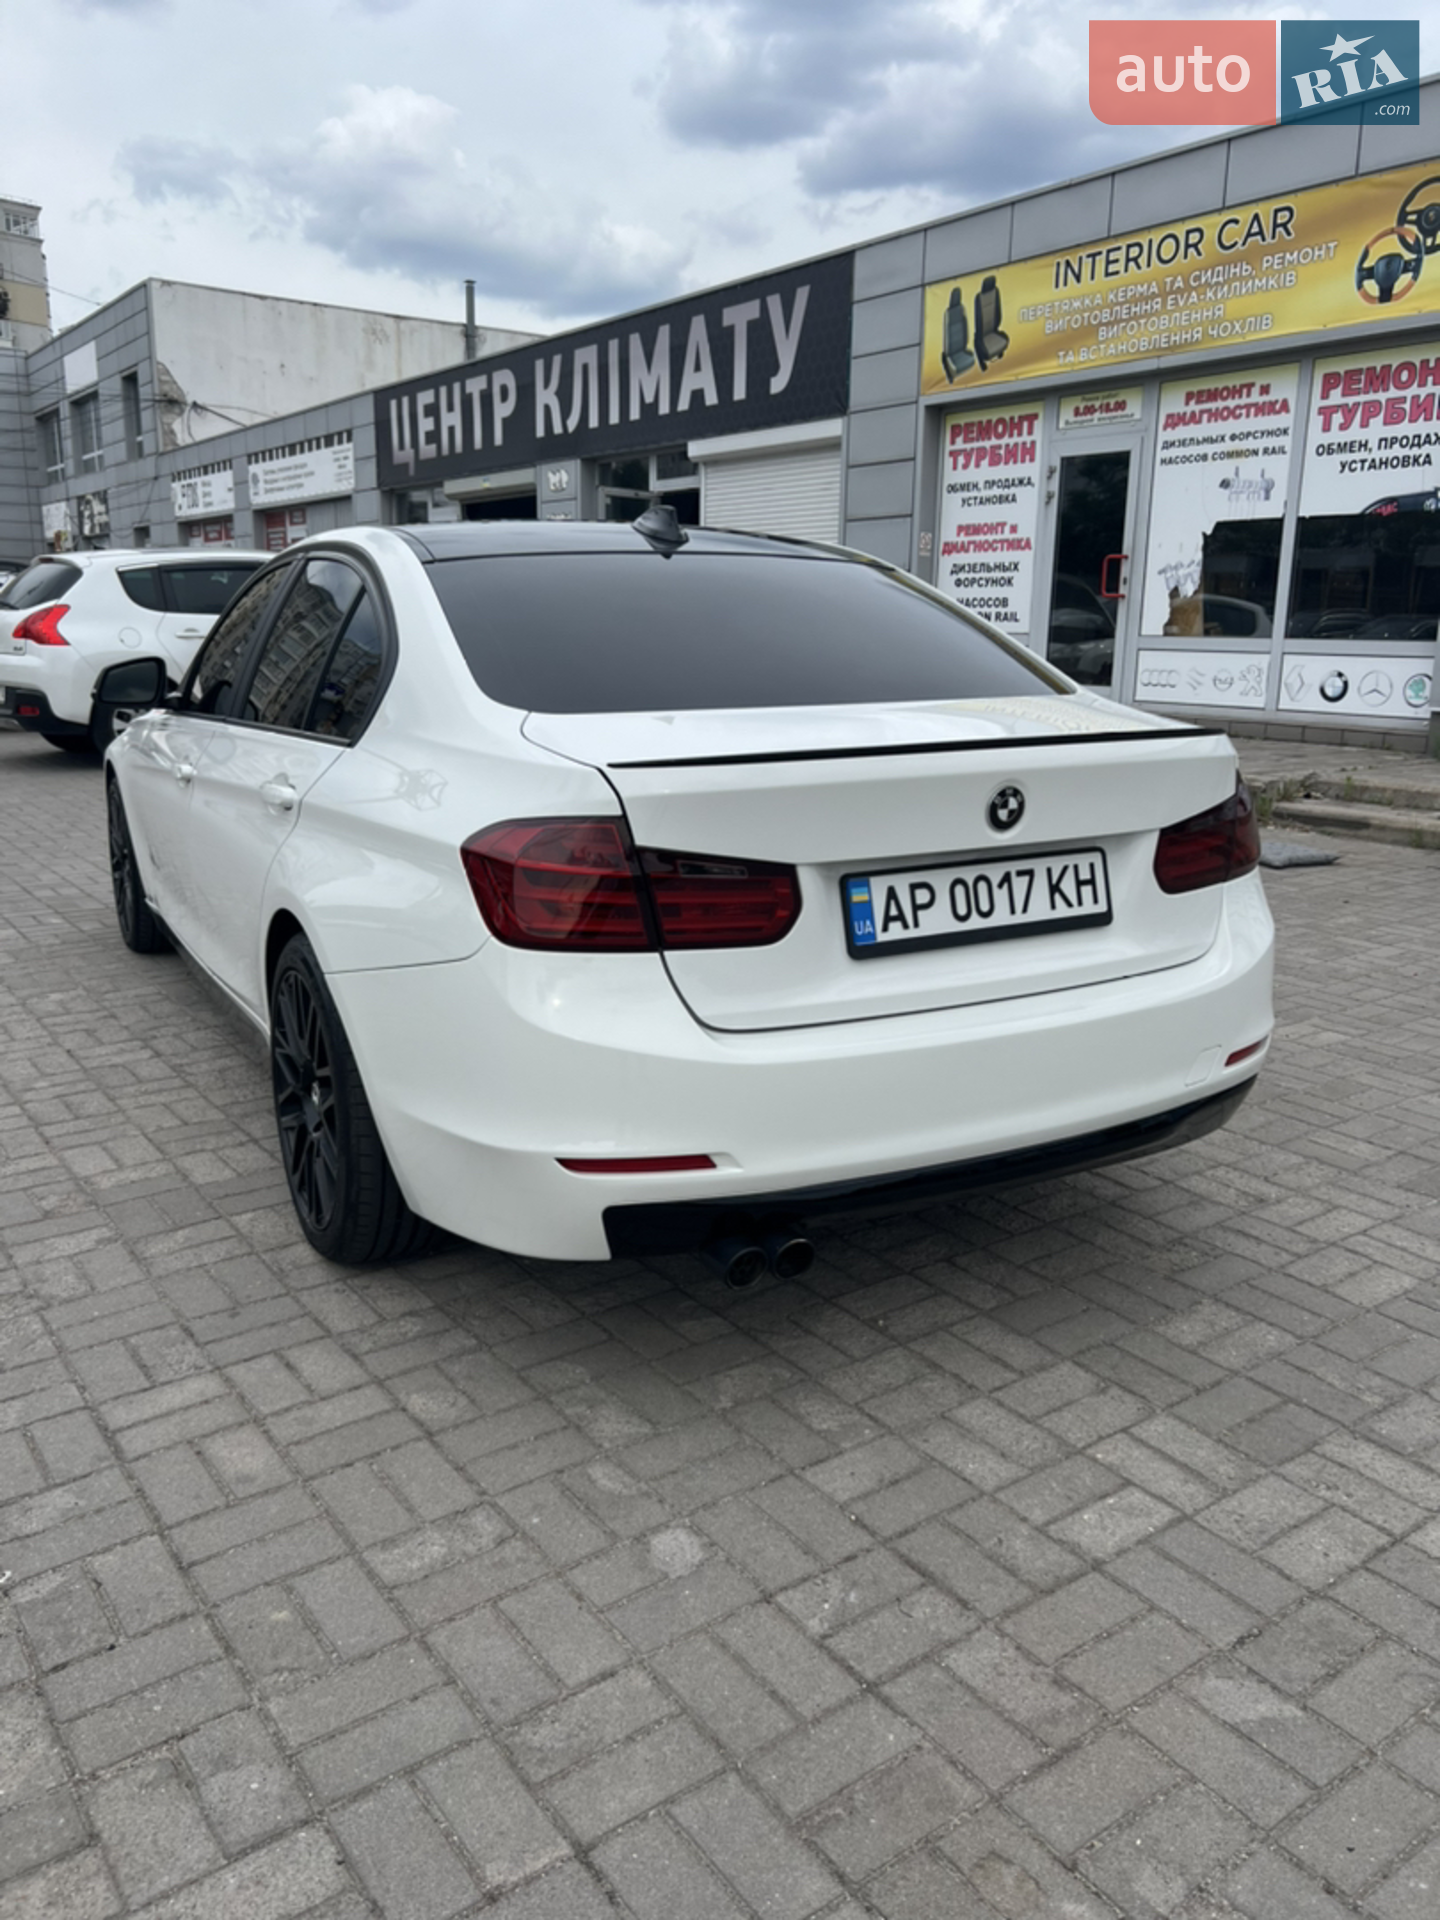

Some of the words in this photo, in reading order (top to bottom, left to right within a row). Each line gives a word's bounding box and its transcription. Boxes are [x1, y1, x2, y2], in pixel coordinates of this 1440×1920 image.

[1054, 227, 1205, 289] INTERIOR
[1216, 205, 1295, 252] CAR
[1019, 294, 1103, 322] ПЕРЕТЯЖКА
[1108, 280, 1159, 303] КЕРМА
[1164, 276, 1184, 292] ТА
[1189, 261, 1256, 286] СИДІНЬ,
[1262, 241, 1338, 271] РЕМОНТ
[1044, 297, 1162, 334] ВИГОТОВЛЕННЯ
[1098, 304, 1224, 341] ВИГОТОВЛЕННЯ
[1057, 351, 1075, 365] ТА
[1079, 327, 1203, 362] ВСТАНОВЛЕННЯ
[1208, 314, 1273, 338] ЧОХЛІВ
[389, 368, 517, 476] ЦЕНТР
[534, 285, 811, 438] КЛІМАТУ
[1184, 381, 1256, 406] РЕМОНТ
[1162, 398, 1290, 431] ДИАГНОСТИКА
[1317, 392, 1440, 433] ТУРБИ
[949, 412, 1039, 446] РЕМОНТ
[1160, 434, 1226, 451] ДИЗЕЛЬНЫХ
[1228, 426, 1290, 442] ФОРСУНОК
[949, 440, 1036, 471] ТУРБИН
[1160, 453, 1208, 466] НАСОСОВ
[1211, 447, 1260, 461] COMMON
[1262, 445, 1288, 457] RAIL
[1315, 438, 1373, 457] ОБМЕН,
[1338, 453, 1433, 474] УСТАНОВКА
[946, 481, 982, 494] ОБМЕН,
[983, 475, 1035, 491] ПРОДАЖА,
[960, 493, 1018, 508] УСТАНОВКА
[956, 521, 1007, 537] РЕМОНТ
[942, 537, 1032, 556] ДИАГНОСТИКА
[949, 561, 1020, 576] ДИЗЕЛЬНЫХ
[953, 576, 1014, 588] ФОРСУНОК
[994, 611, 1020, 622] RAIL
[881, 881, 936, 933] AP
[949, 868, 1035, 922] 0017
[1045, 861, 1099, 910] KH
[854, 919, 874, 935] UA
